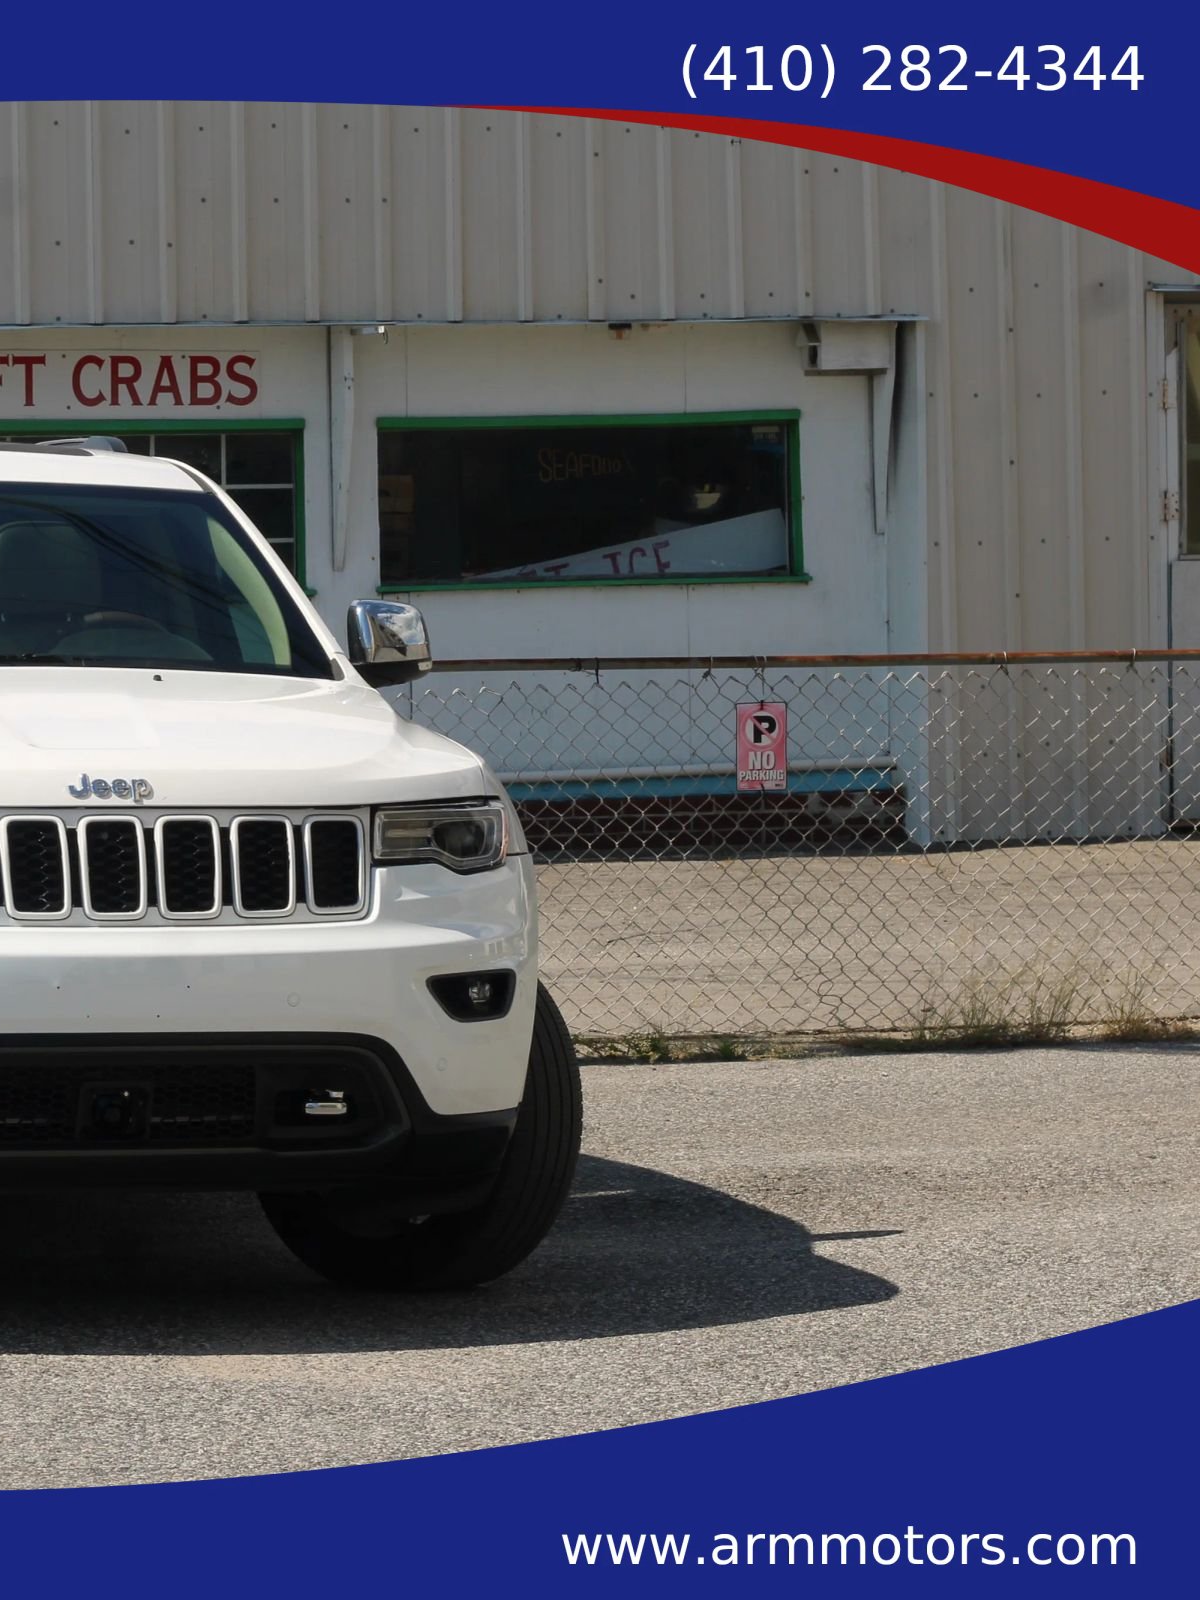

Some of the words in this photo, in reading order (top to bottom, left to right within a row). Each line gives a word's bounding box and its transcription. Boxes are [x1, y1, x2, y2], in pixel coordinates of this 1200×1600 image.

[72, 354, 259, 408] CRABS
[748, 750, 776, 771] NO
[68, 772, 153, 803] Jeep
[738, 769, 785, 782] PARKING
